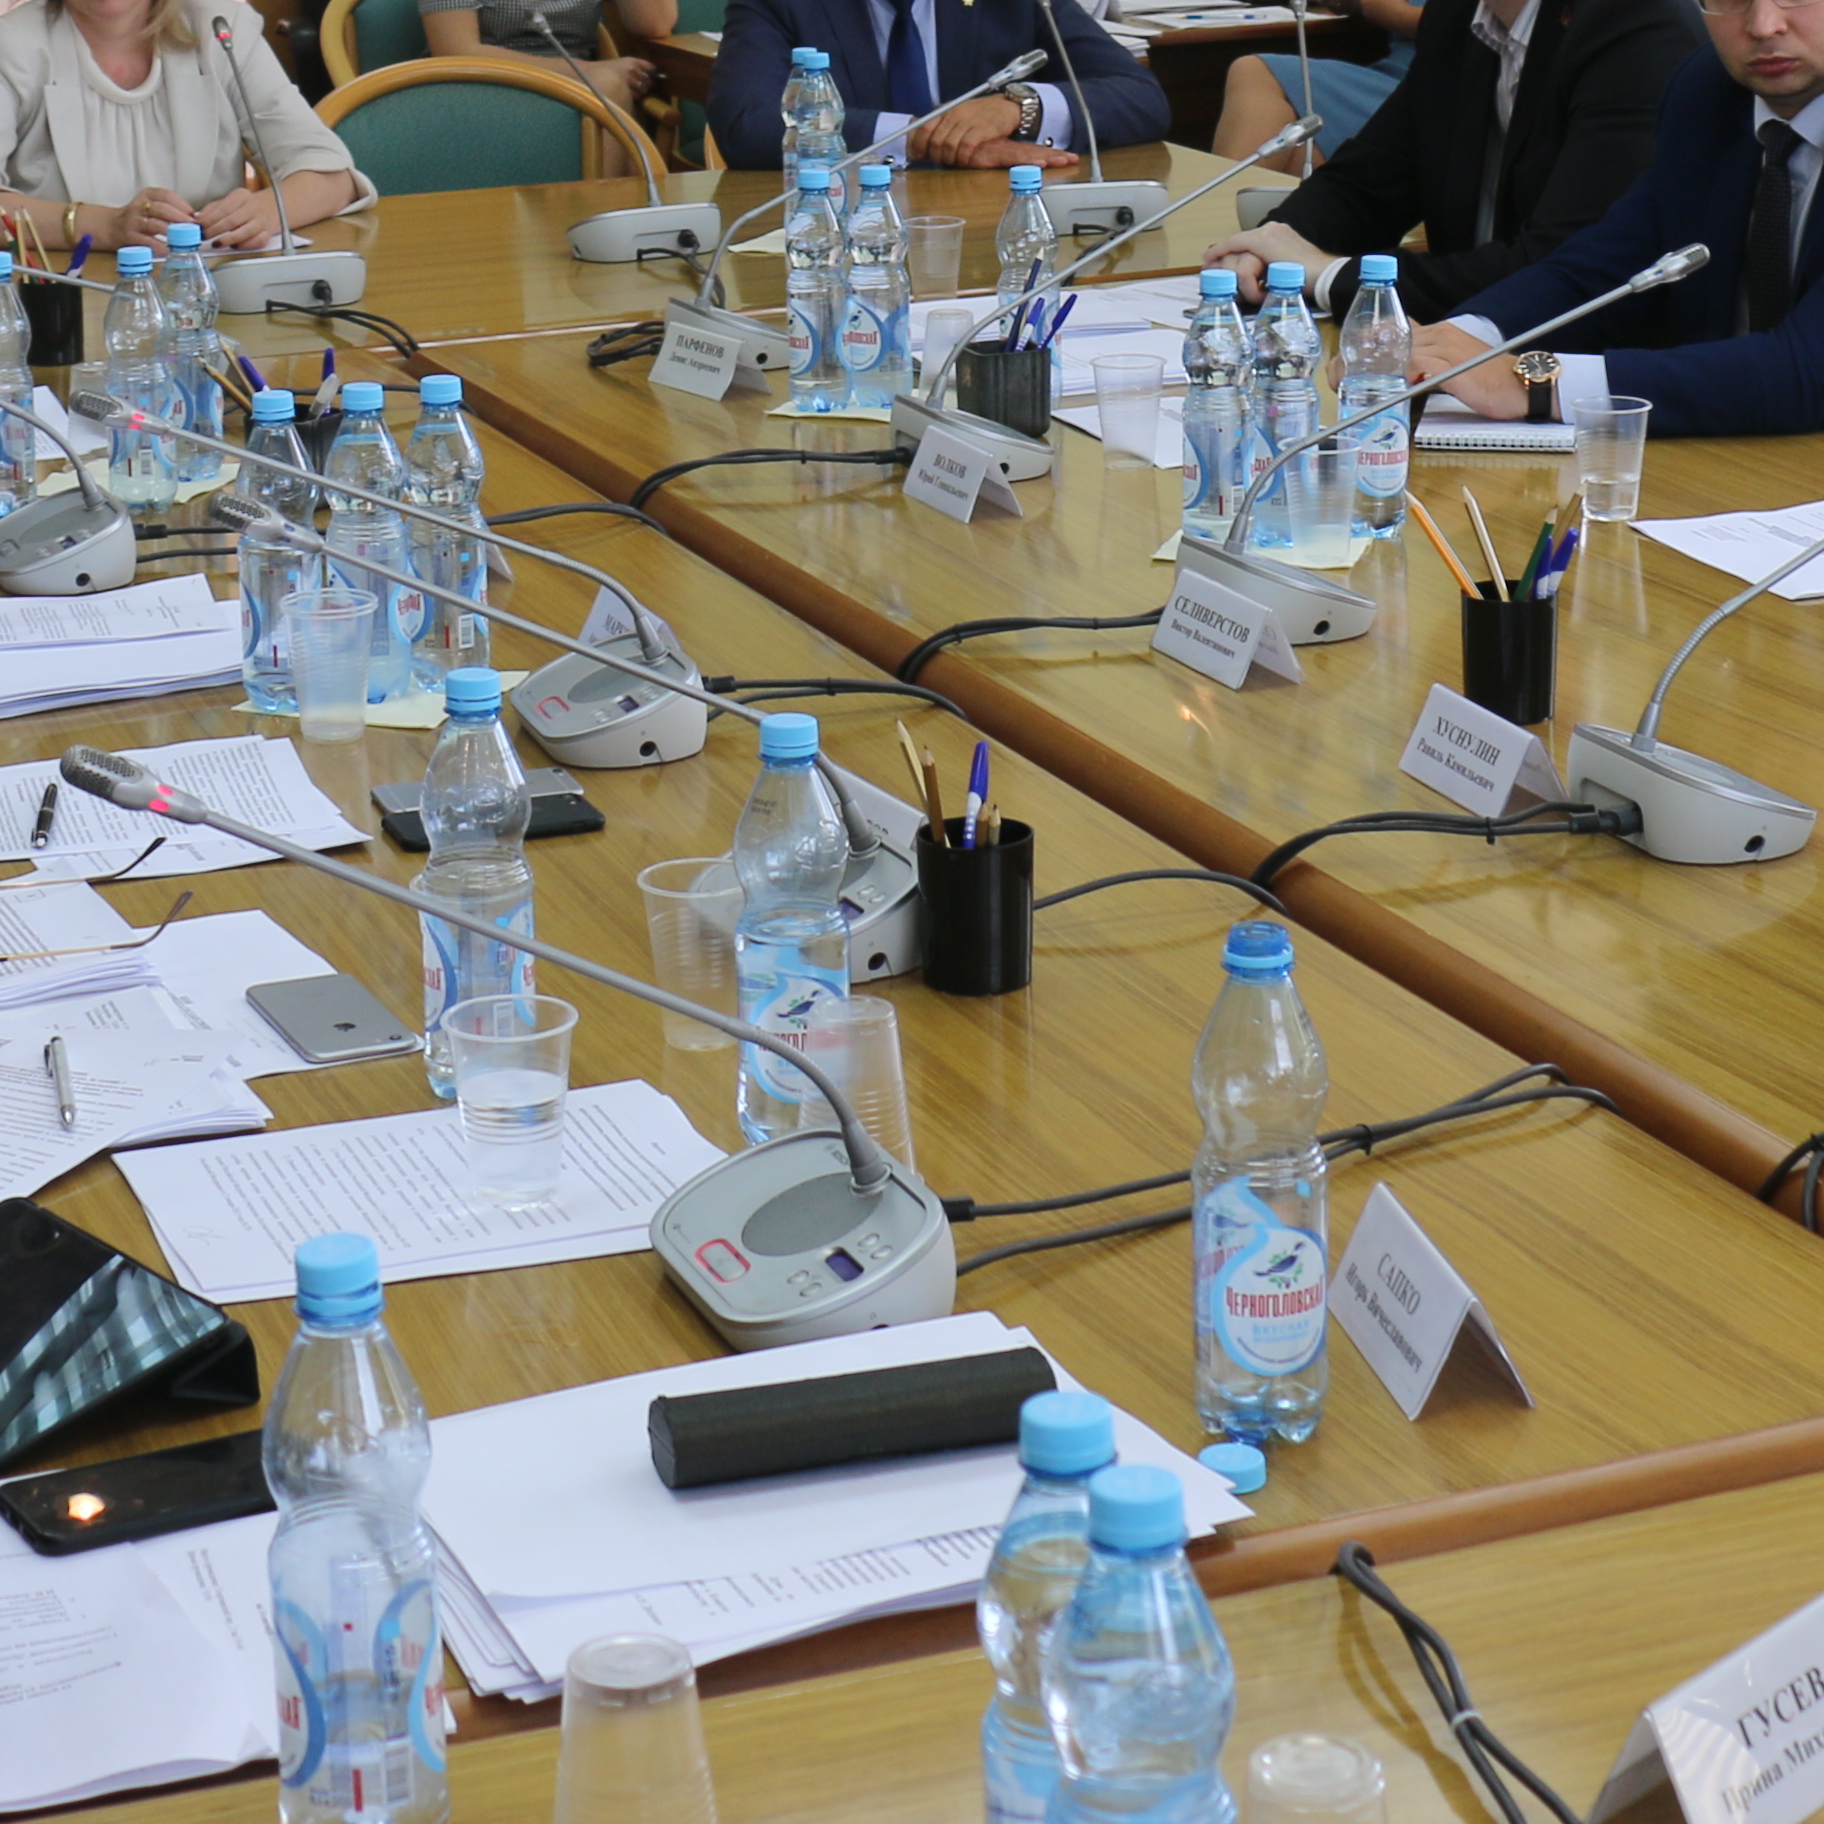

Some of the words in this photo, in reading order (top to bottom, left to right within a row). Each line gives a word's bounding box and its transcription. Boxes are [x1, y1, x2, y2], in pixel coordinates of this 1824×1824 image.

[676, 335, 725, 359] ПАРФЕНОВ
[933, 454, 967, 479] ВОЛКОВ
[1174, 595, 1251, 643] СЕЛИВЕРСТОВ
[1432, 716, 1501, 766] ХУСНУЛИН
[1377, 1252, 1421, 1315] САПКО
[1721, 1762, 1784, 1814] Ирина
